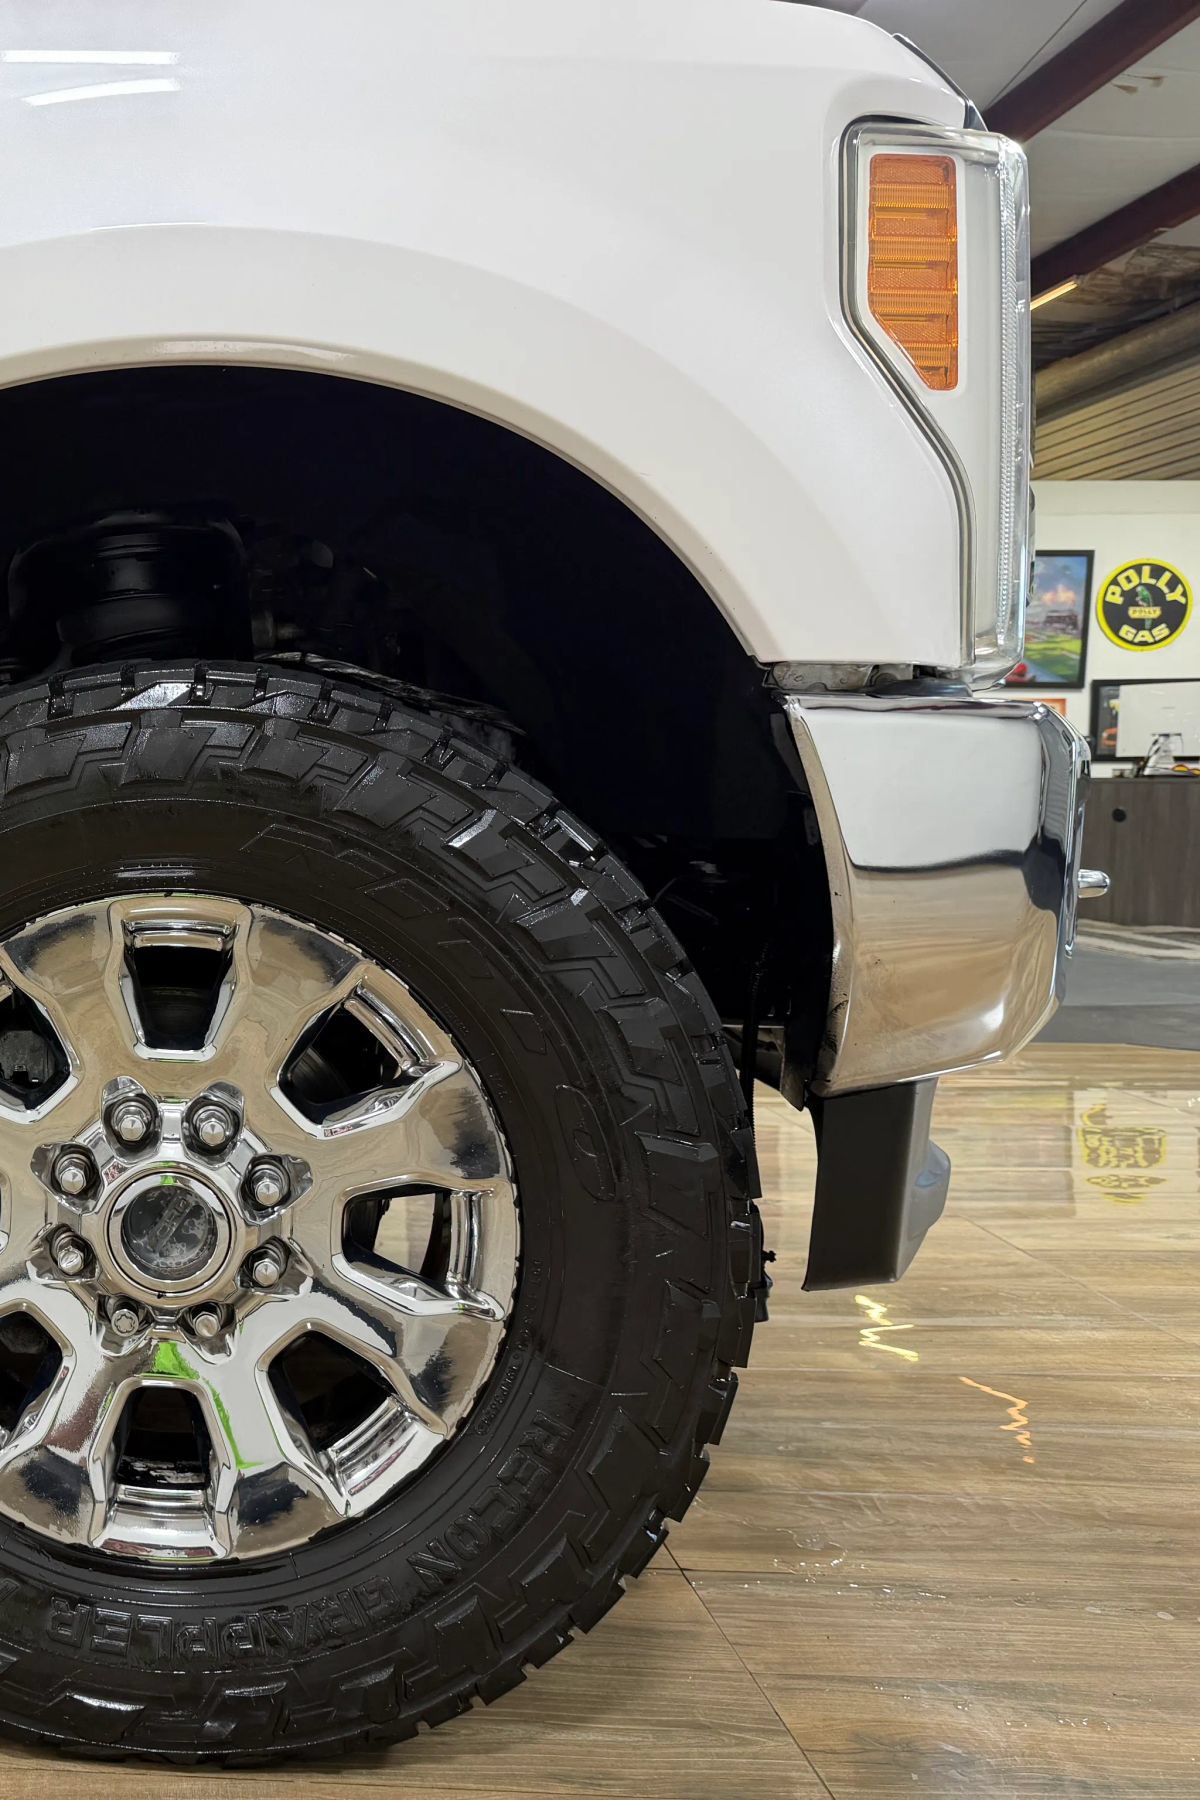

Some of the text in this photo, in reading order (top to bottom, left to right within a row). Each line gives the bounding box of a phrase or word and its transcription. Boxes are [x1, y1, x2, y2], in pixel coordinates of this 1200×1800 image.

[1105, 565, 1187, 605] POLLY
[1118, 622, 1170, 643] GAS
[407, 1407, 576, 1591] RECON
[48, 1574, 399, 1659] GRAPPLER
